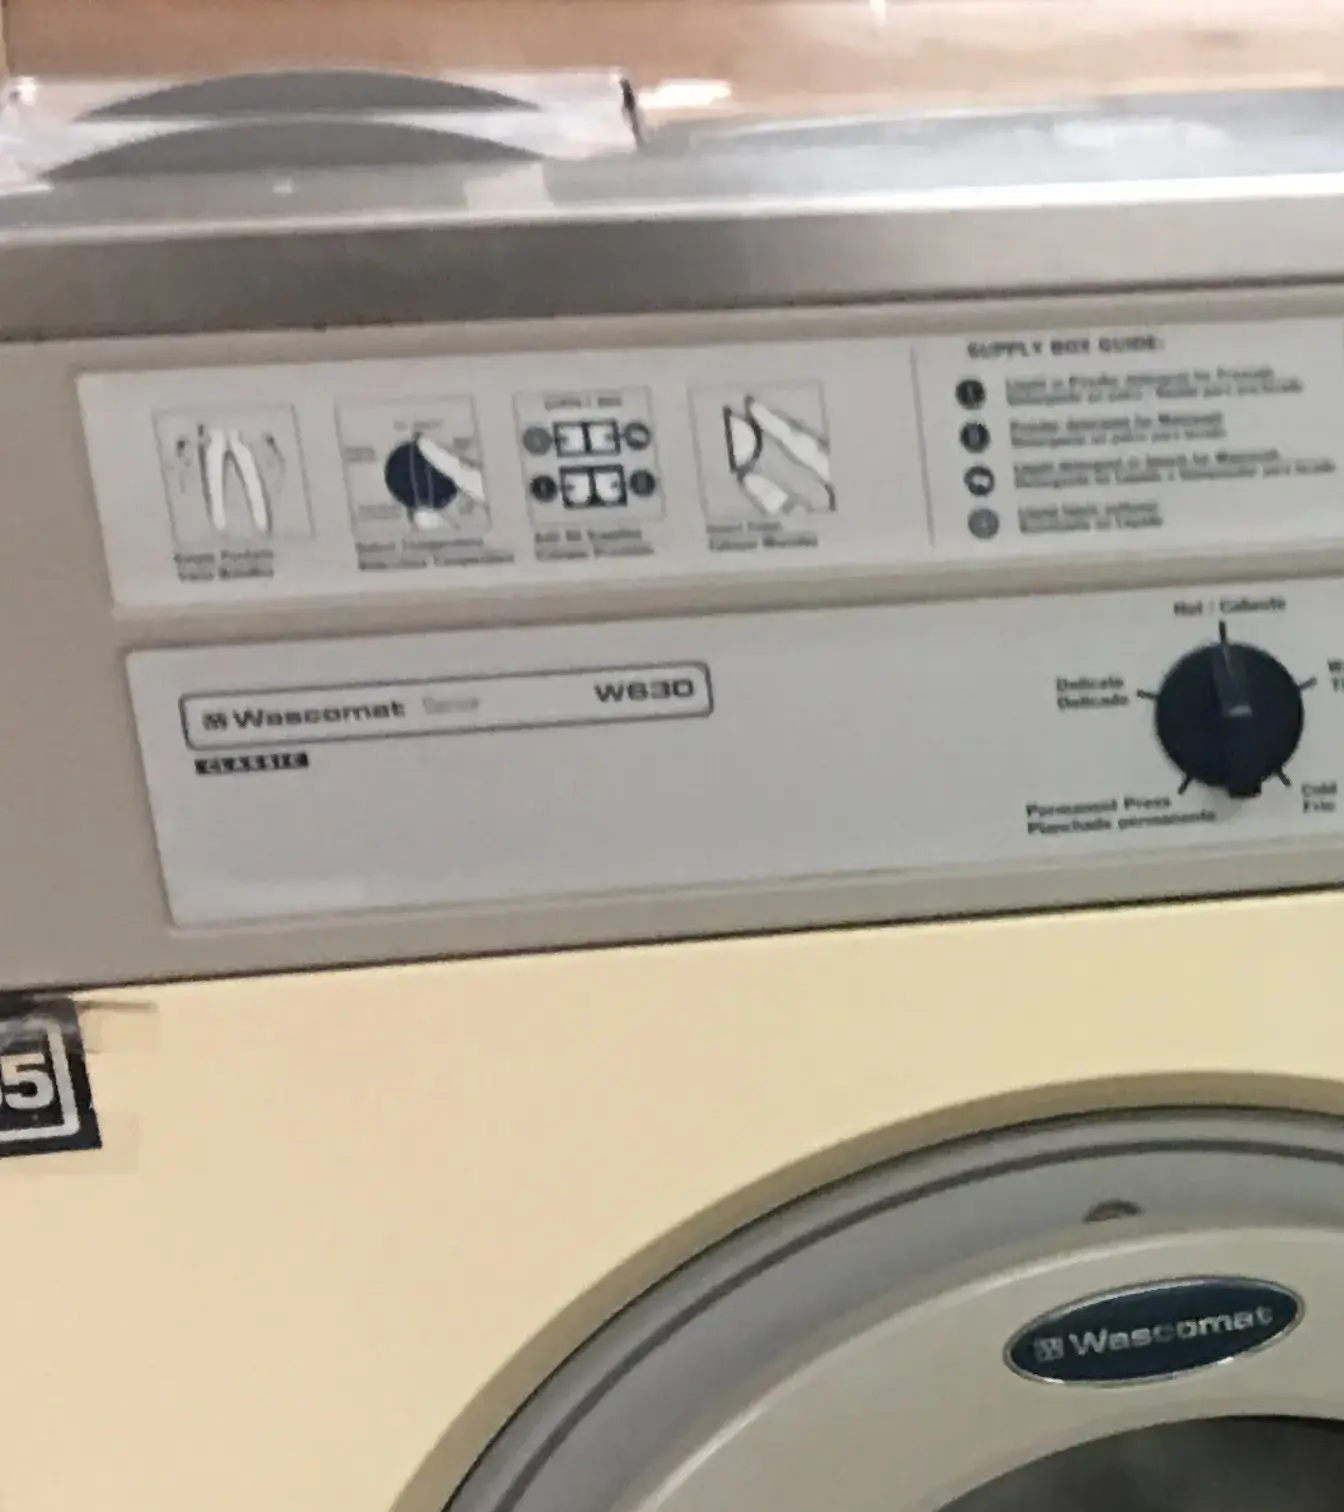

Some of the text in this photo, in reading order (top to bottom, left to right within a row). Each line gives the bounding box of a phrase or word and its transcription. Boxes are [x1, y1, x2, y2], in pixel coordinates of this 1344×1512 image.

[232, 700, 406, 729] Wascomat
[594, 678, 695, 703] W630
[0, 1051, 55, 1110] 5
[1069, 1304, 1275, 1356] Wascomat
